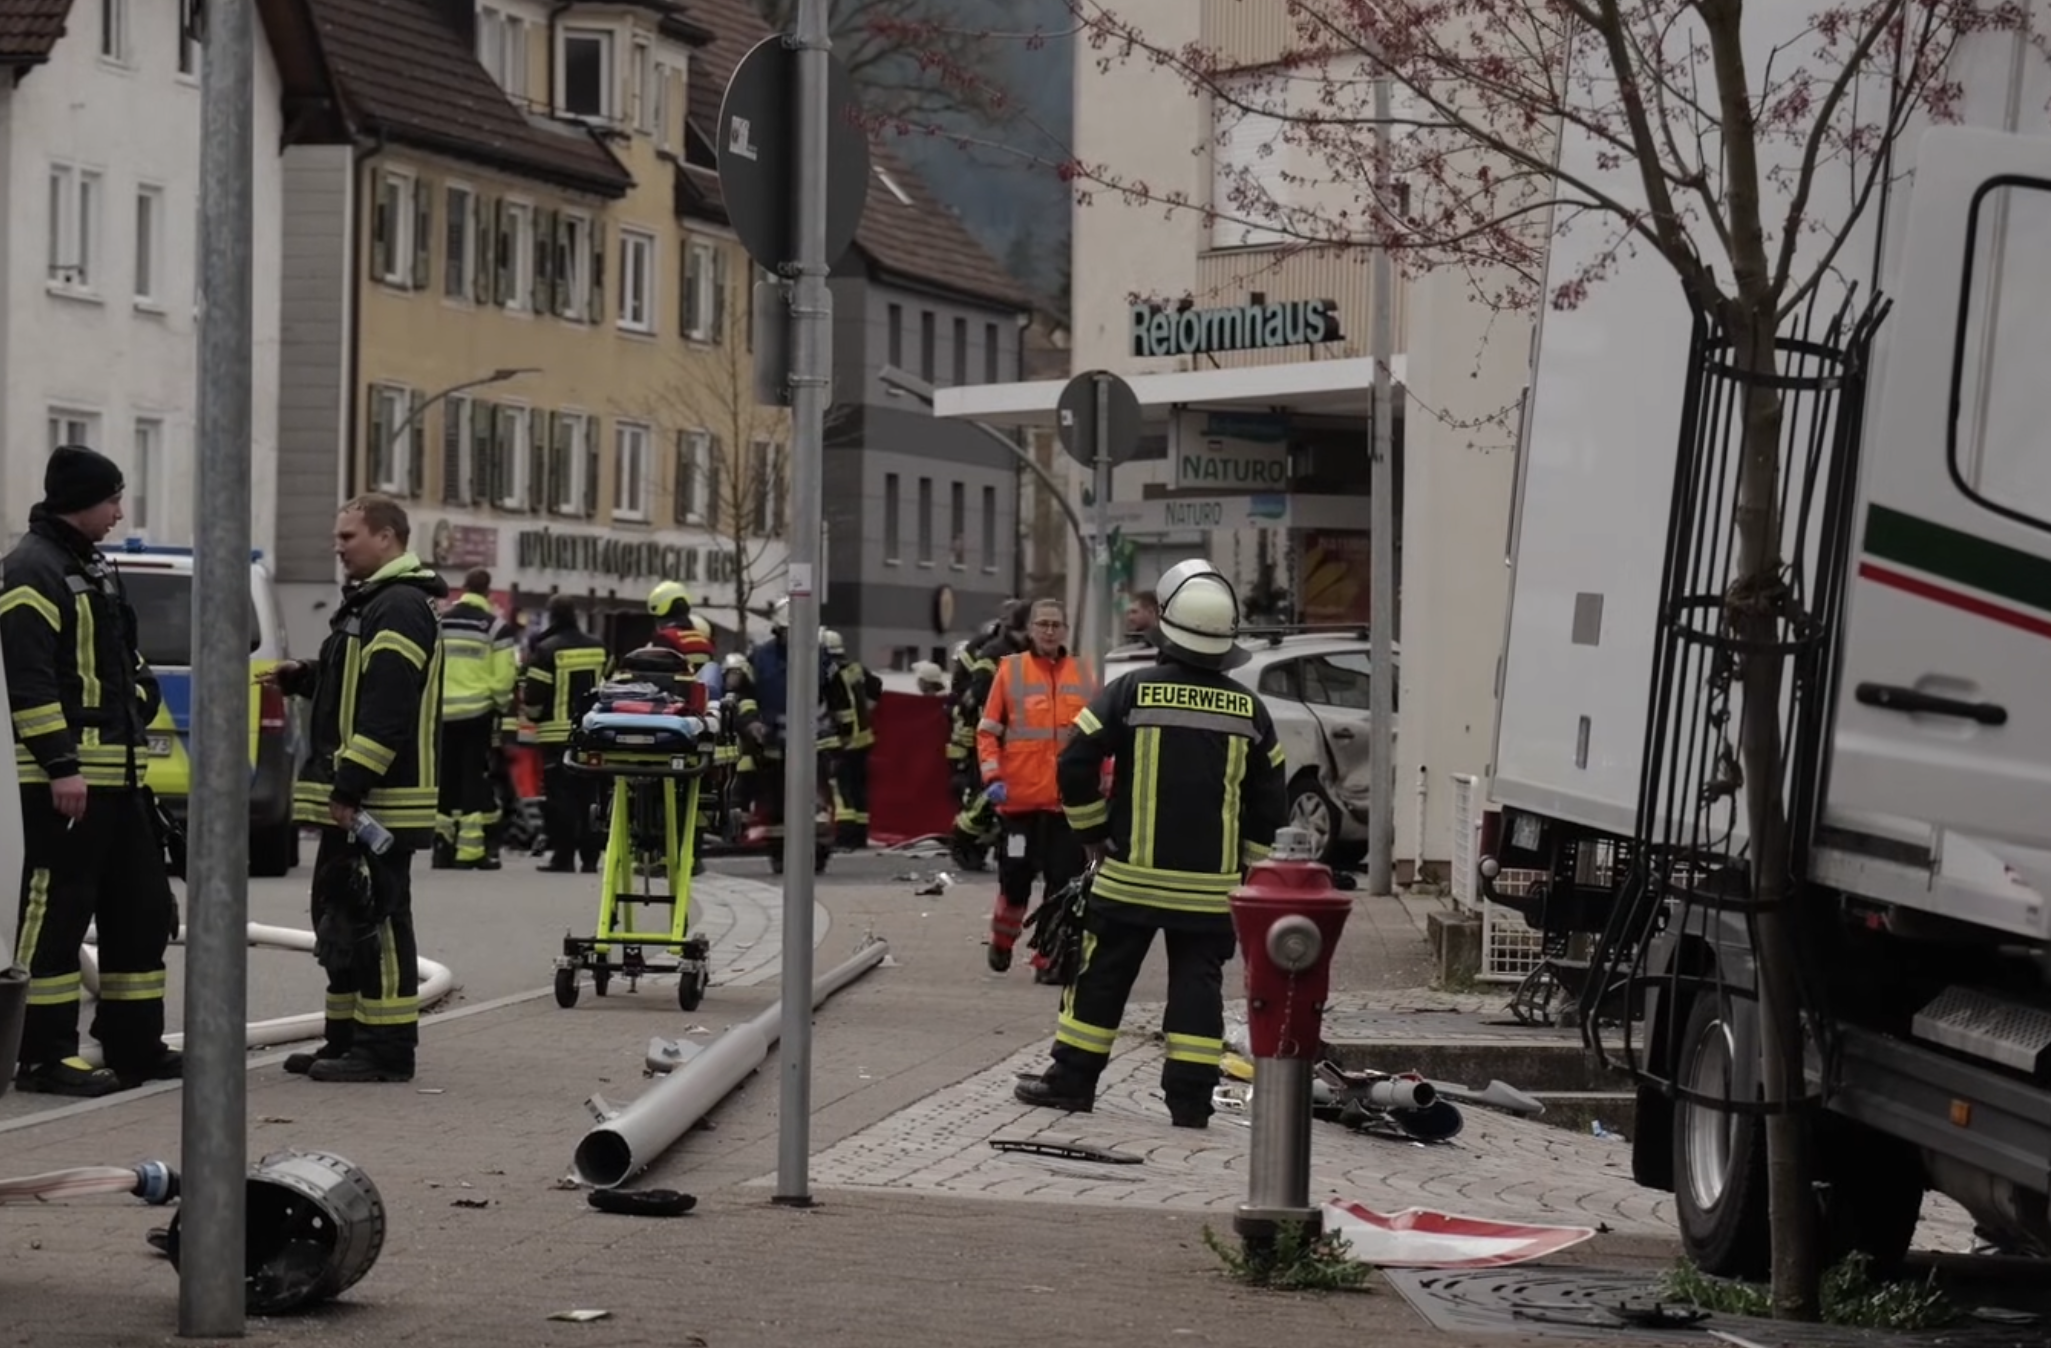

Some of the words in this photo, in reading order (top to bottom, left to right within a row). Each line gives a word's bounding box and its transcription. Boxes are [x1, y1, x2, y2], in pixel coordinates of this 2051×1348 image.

[1131, 298, 1330, 357] Reformhaus
[1182, 455, 1284, 483] NATURO
[1165, 502, 1223, 526] NATURO
[1141, 686, 1249, 713] FEUERWEHR
